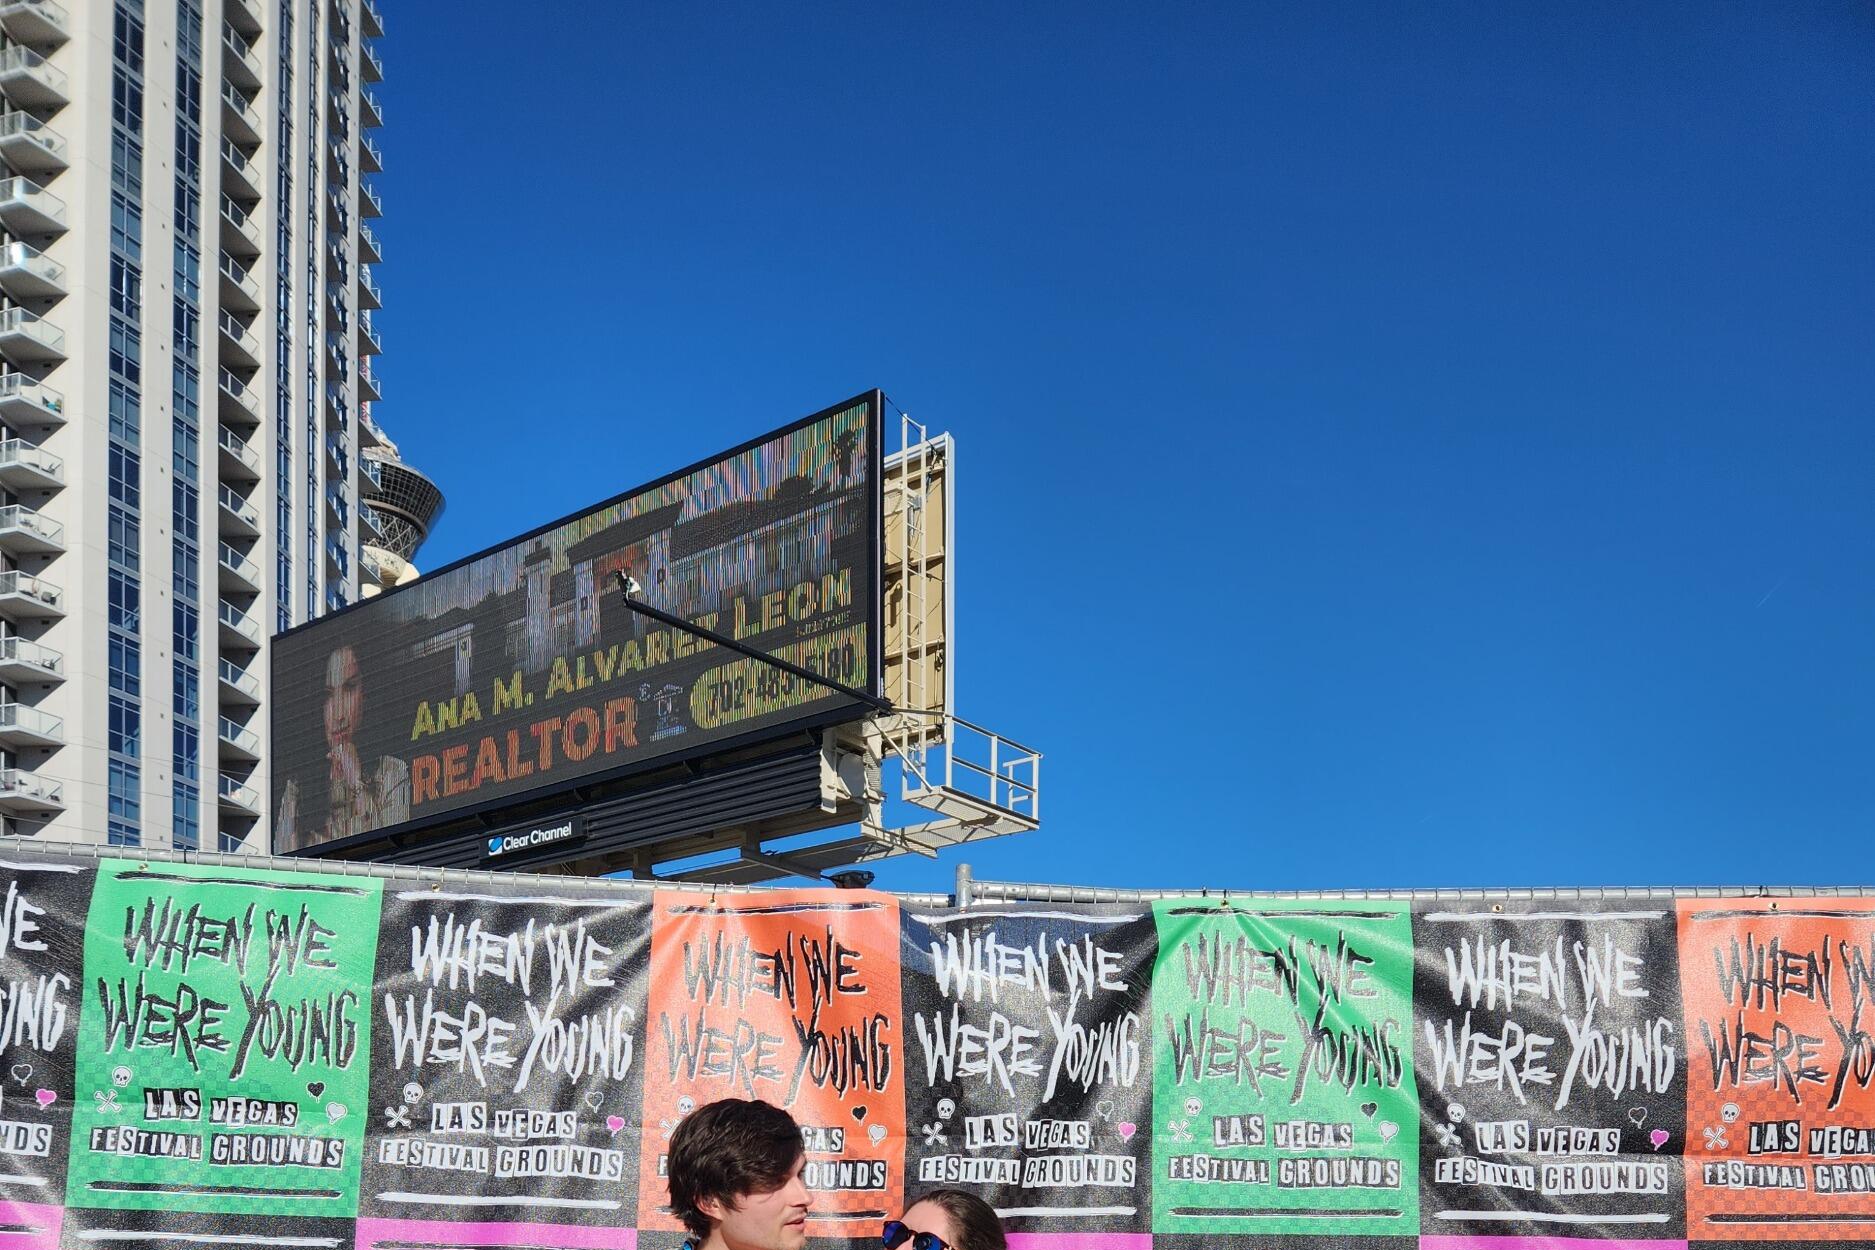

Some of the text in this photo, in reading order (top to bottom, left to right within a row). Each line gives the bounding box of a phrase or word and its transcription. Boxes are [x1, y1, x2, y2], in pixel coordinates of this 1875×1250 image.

[411, 692, 484, 741] ANA
[492, 670, 534, 715] M.
[734, 567, 852, 642] LEON
[411, 696, 640, 805] REALTOR
[503, 821, 572, 851] Clear Channel
[126, 898, 338, 976] WHEN WE
[414, 915, 615, 1000] WHEN WE
[686, 927, 867, 1010] WHEN WE
[932, 930, 1128, 1003] WHEN WE
[1184, 931, 1378, 1007] WHEN WE
[1447, 935, 1649, 1012] WHEN WE
[1716, 934, 1833, 1015] WHEN
[100, 967, 359, 1081] WERE YOUNG
[387, 987, 635, 1093] WERE YOUNG
[662, 996, 890, 1108] WERE YOUNG
[916, 991, 1139, 1103] WERE YOUNG
[1166, 996, 1401, 1106] WERE YOUNG
[1427, 1000, 1675, 1111] WERE YOUNG
[1701, 1012, 1830, 1106] WERE
[146, 1090, 296, 1126] LAS VEGAS
[433, 1104, 574, 1140] LAS VEGAS
[802, 1127, 843, 1153] GAS
[967, 1115, 1087, 1150] LAS VEGAS
[1215, 1116, 1350, 1150] LAS VEGAS
[1477, 1122, 1619, 1156] LAS VEGAS
[1750, 1122, 1875, 1157] LAS VEGA
[92, 1128, 342, 1168] FESTIVAL GROUNDS
[381, 1141, 487, 1173] FESTIVAL
[497, 1148, 621, 1180] GROUNDS
[806, 1162, 885, 1190] OUNDS
[921, 1157, 1134, 1187] FESTIVAL GROUNDS
[1170, 1156, 1399, 1189] FESTIVAL GROUNDS
[1437, 1158, 1666, 1194] FESTIVAL GROUNDS
[1706, 1162, 1805, 1189] FESTIVAL
